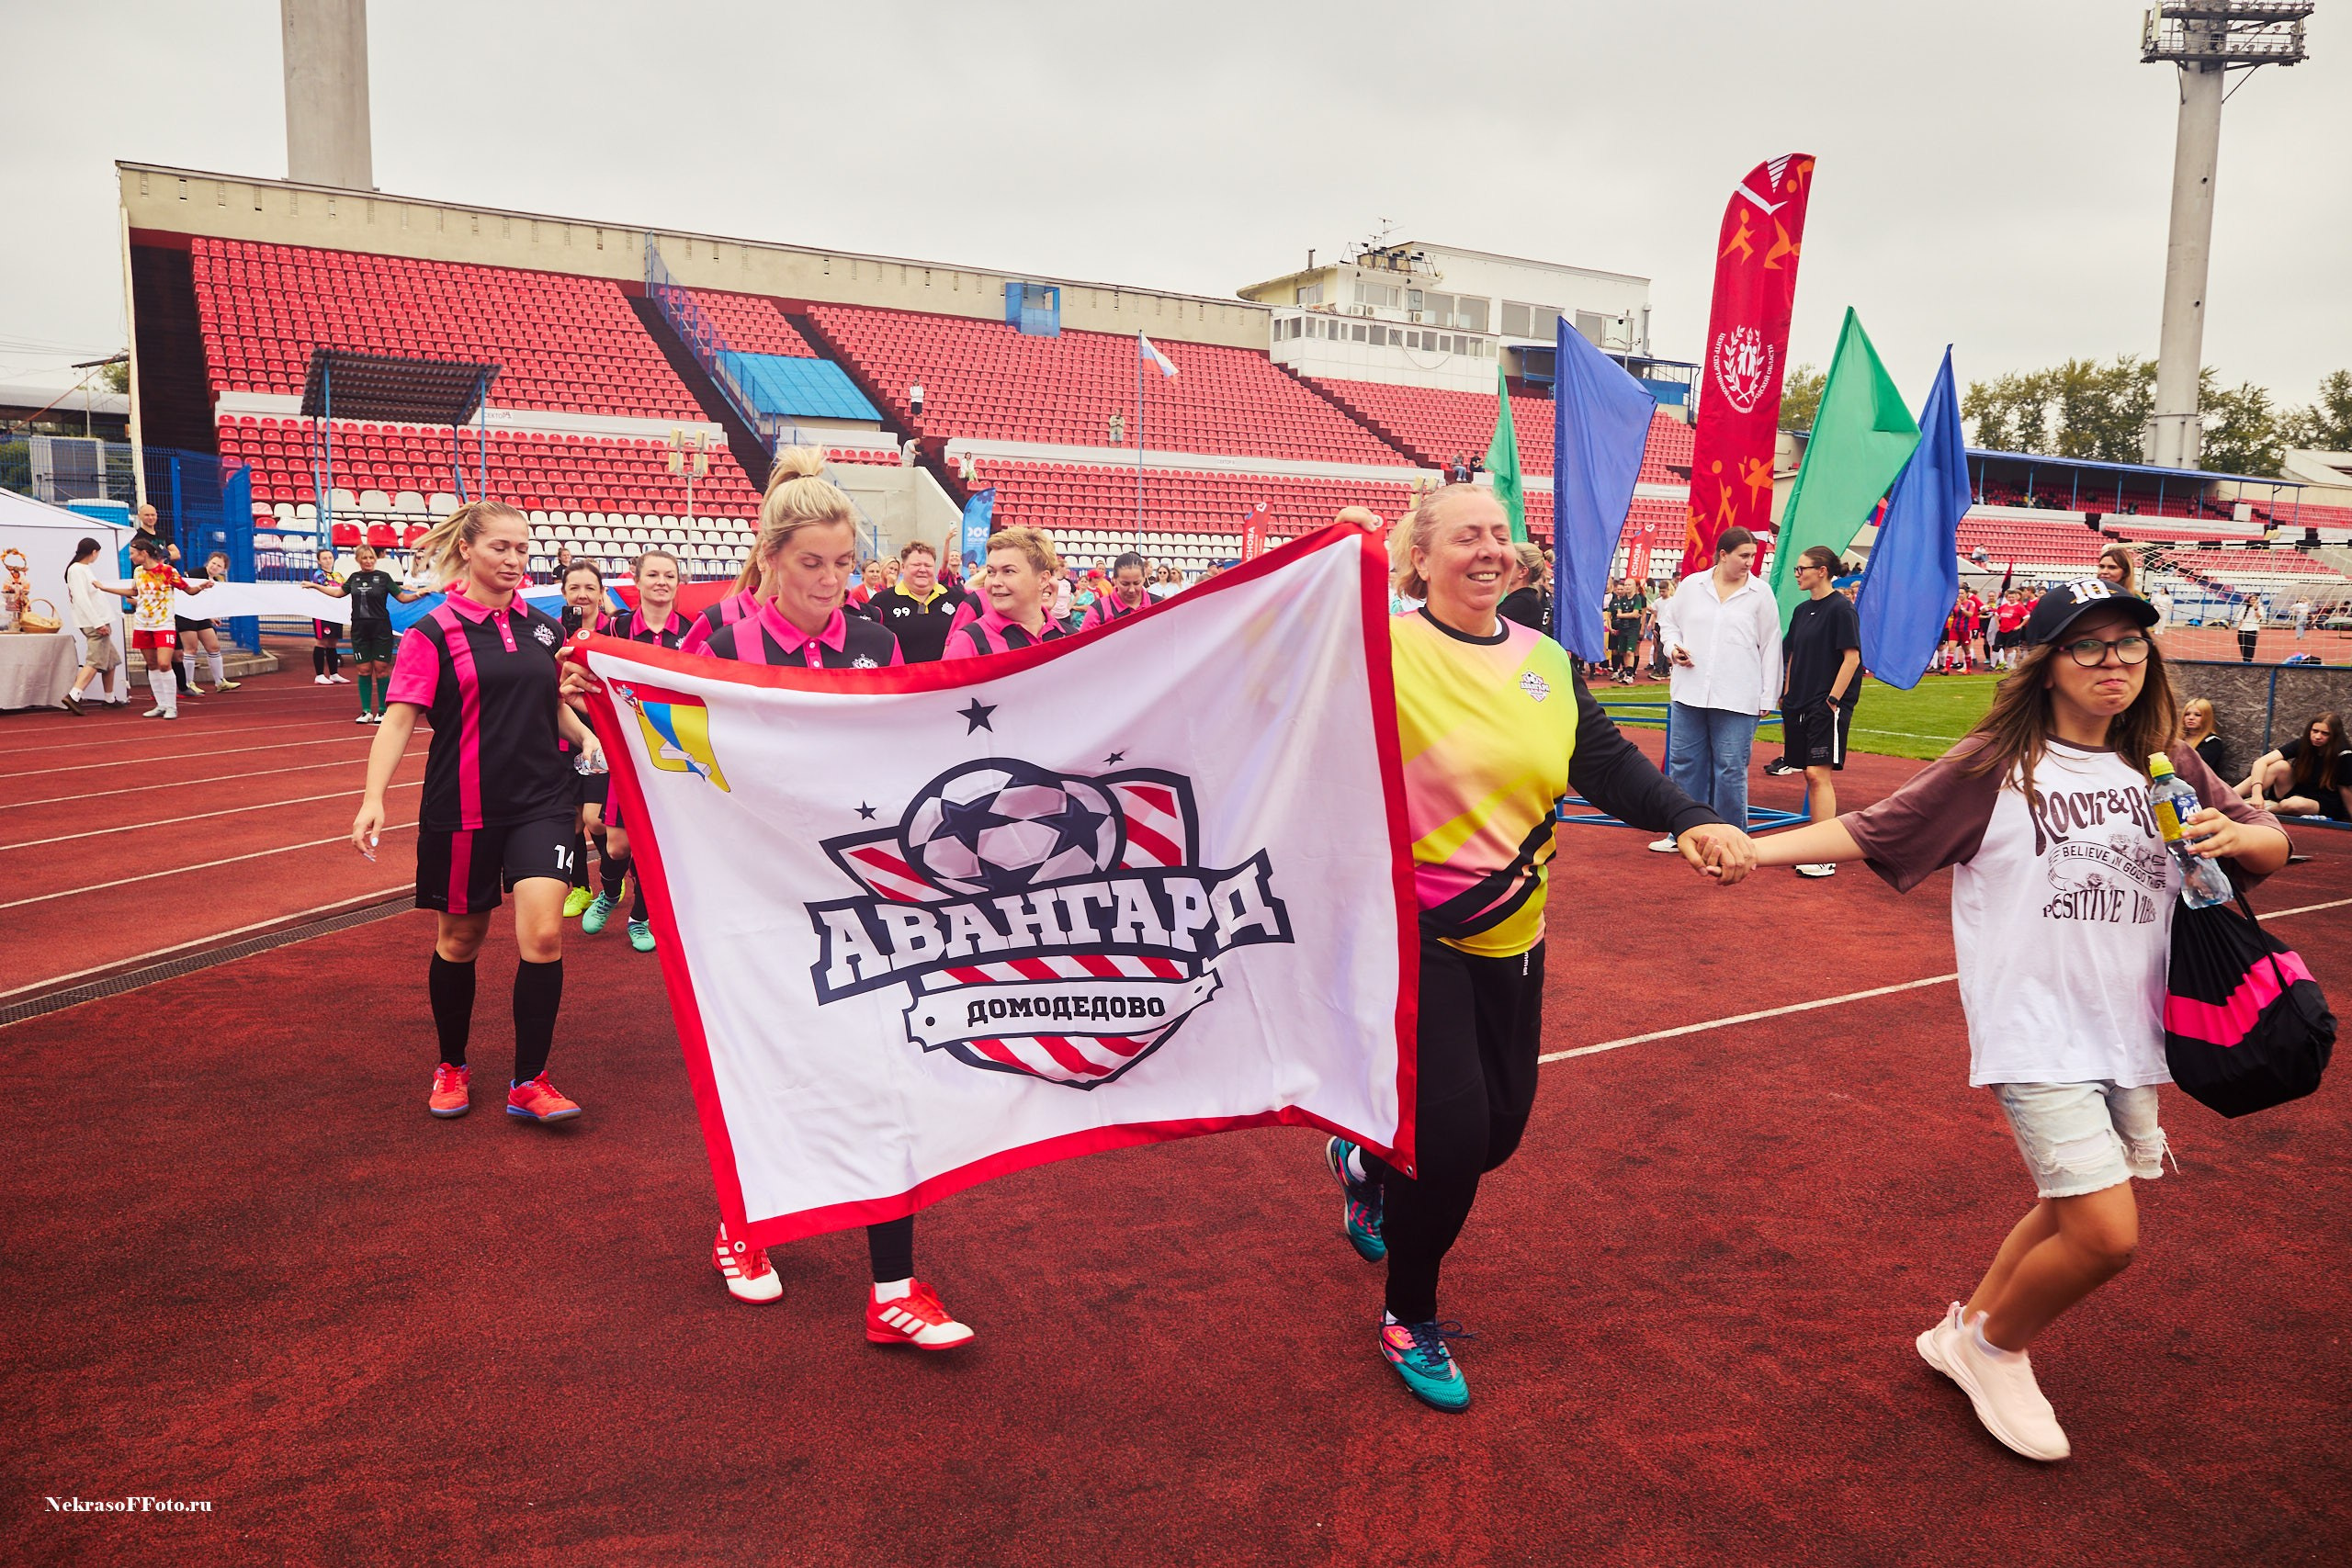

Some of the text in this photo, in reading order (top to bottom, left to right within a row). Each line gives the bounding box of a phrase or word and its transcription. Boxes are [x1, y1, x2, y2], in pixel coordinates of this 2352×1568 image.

[1246, 526, 1256, 560] СНОВА
[1631, 543, 1643, 577] ОСНОВА
[2069, 580, 2111, 604] 10
[893, 606, 910, 618] 99
[165, 634, 175, 645] 15
[554, 844, 574, 874] 14
[2063, 846, 2110, 862] BELIEVE
[2112, 856, 2123, 867] IN
[2042, 888, 2125, 923] POSITIVE
[819, 863, 1281, 990] АВАНГАРД
[967, 996, 1166, 1028] ДОМОДЕДОВО
